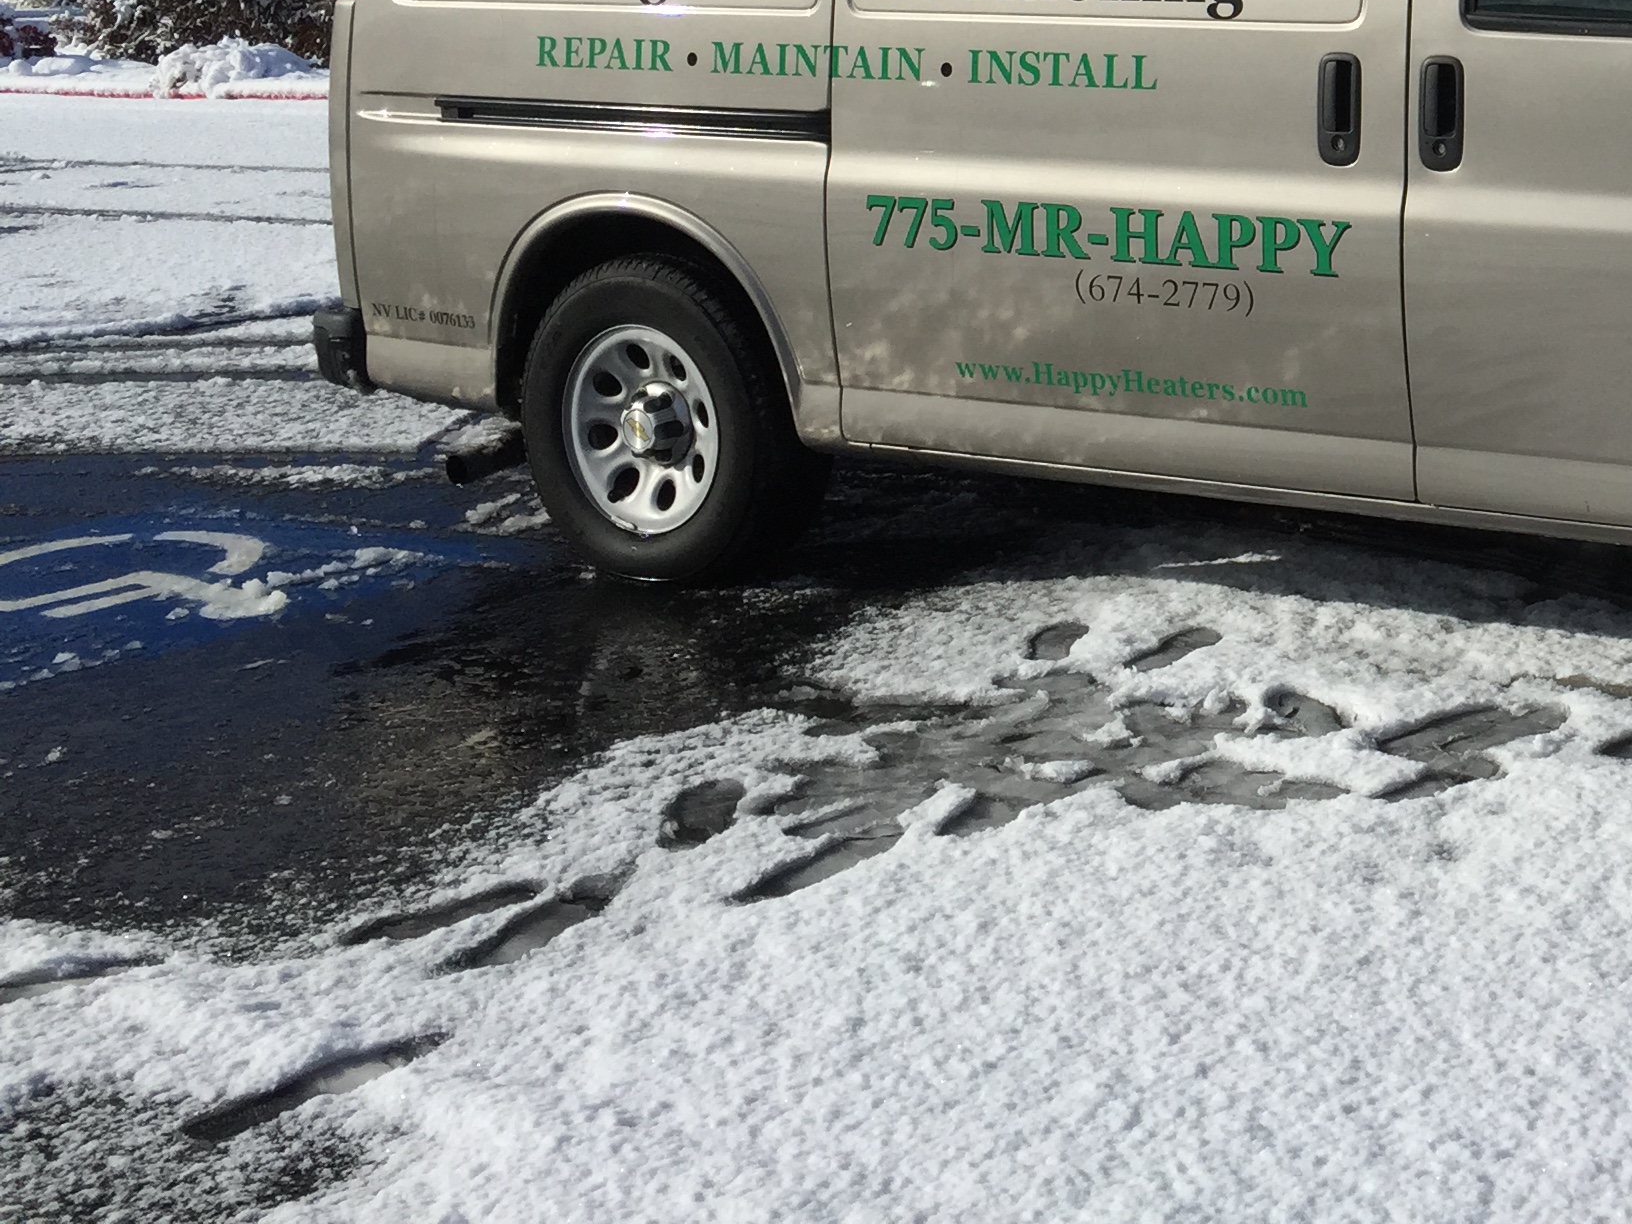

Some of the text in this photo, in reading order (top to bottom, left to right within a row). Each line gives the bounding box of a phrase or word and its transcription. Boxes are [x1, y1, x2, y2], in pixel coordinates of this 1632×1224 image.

[536, 36, 1159, 90] REPAIR MAINTAIN INSTALL
[866, 194, 1353, 278] 775-MR-HAPPY
[371, 302, 392, 318] NV
[395, 305, 426, 322] LIC#
[1075, 269, 1256, 317] (674-2779)
[955, 361, 1309, 408] www.HappyHeaters.com
